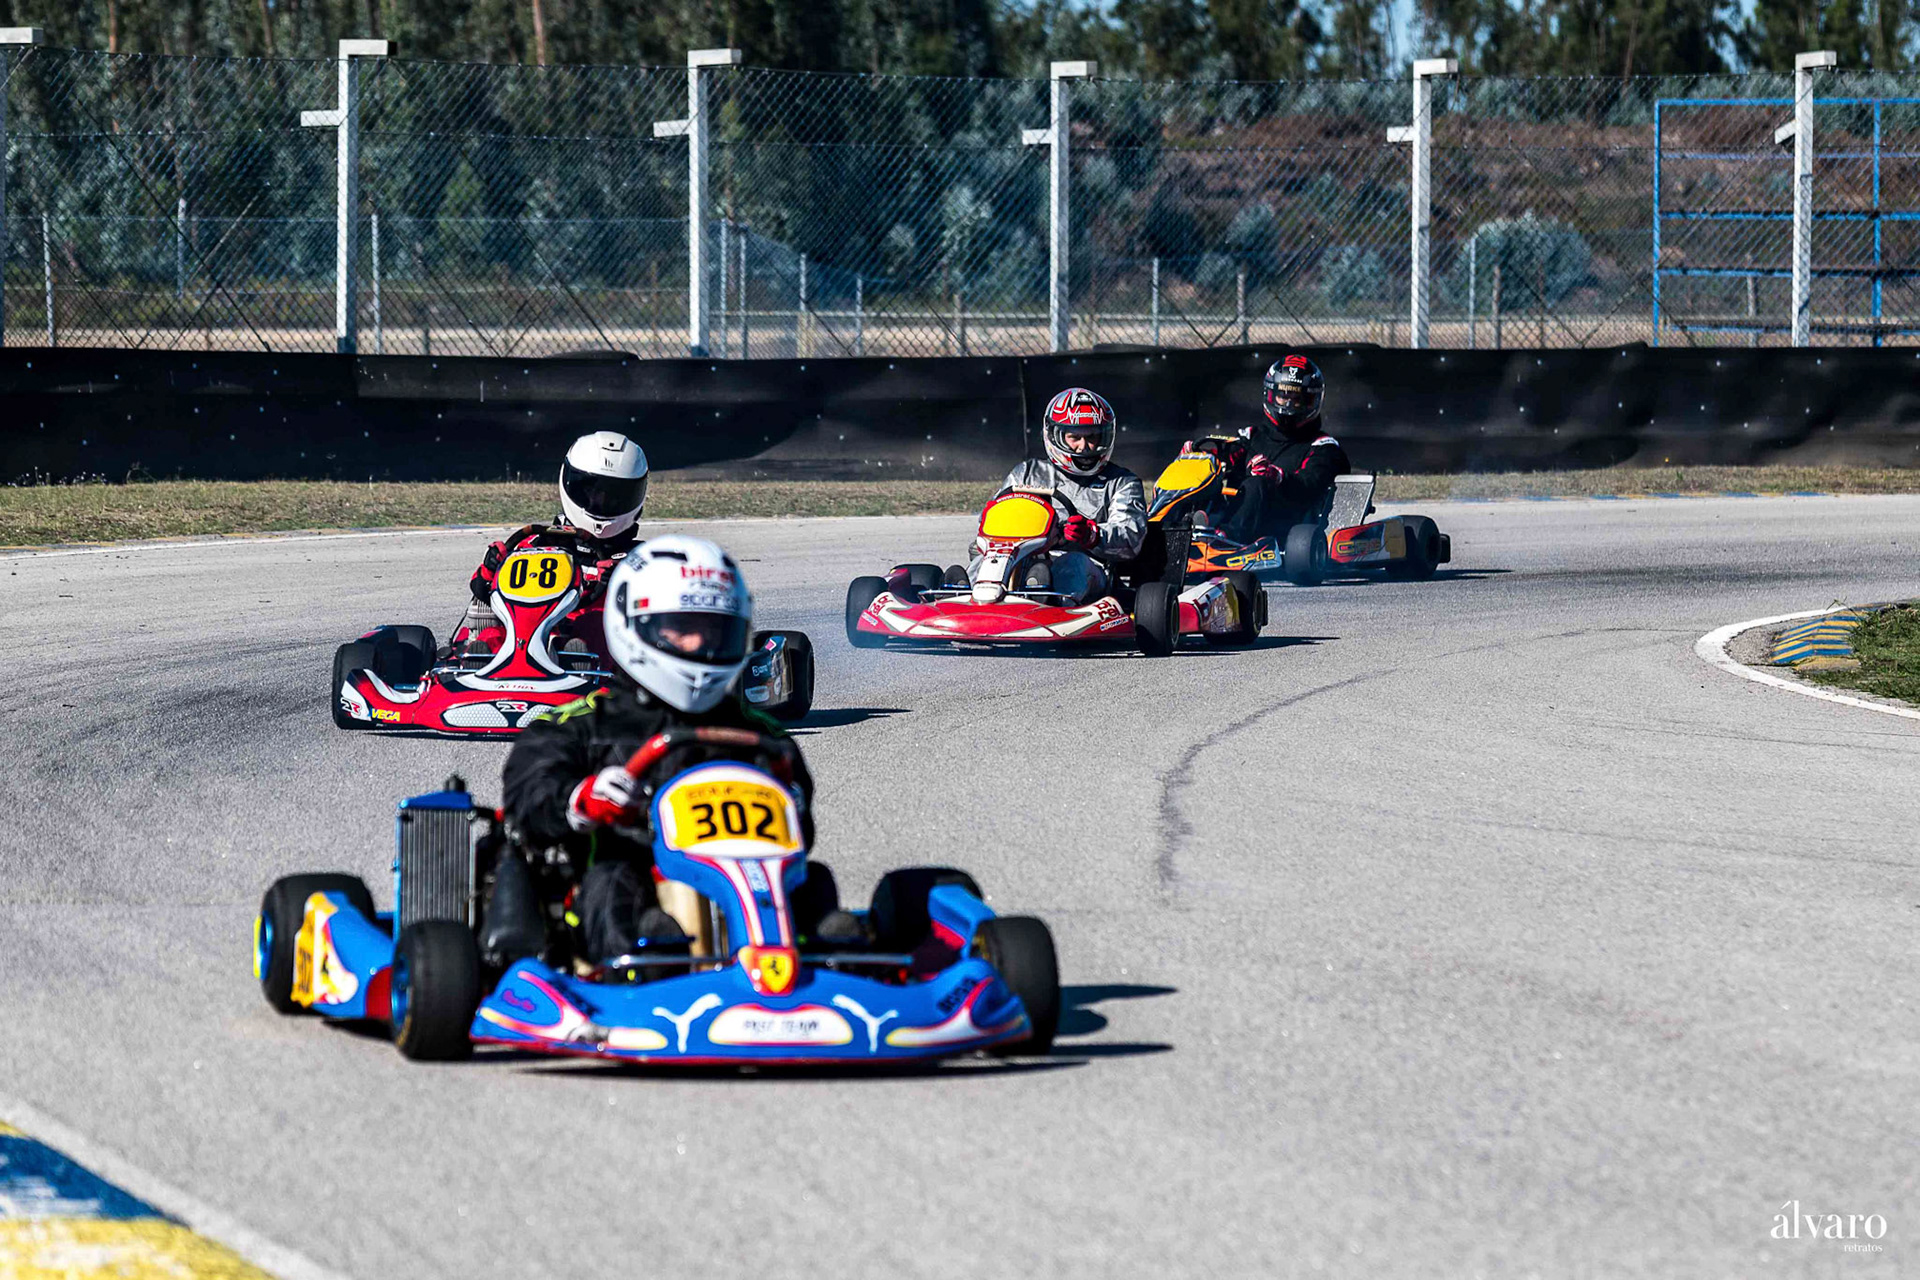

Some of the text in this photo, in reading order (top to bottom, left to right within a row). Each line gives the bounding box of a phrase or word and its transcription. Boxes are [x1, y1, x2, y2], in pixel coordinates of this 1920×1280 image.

[1226, 550, 1277, 567] CRG
[371, 708, 401, 722] VEGA
[691, 801, 779, 841] 302
